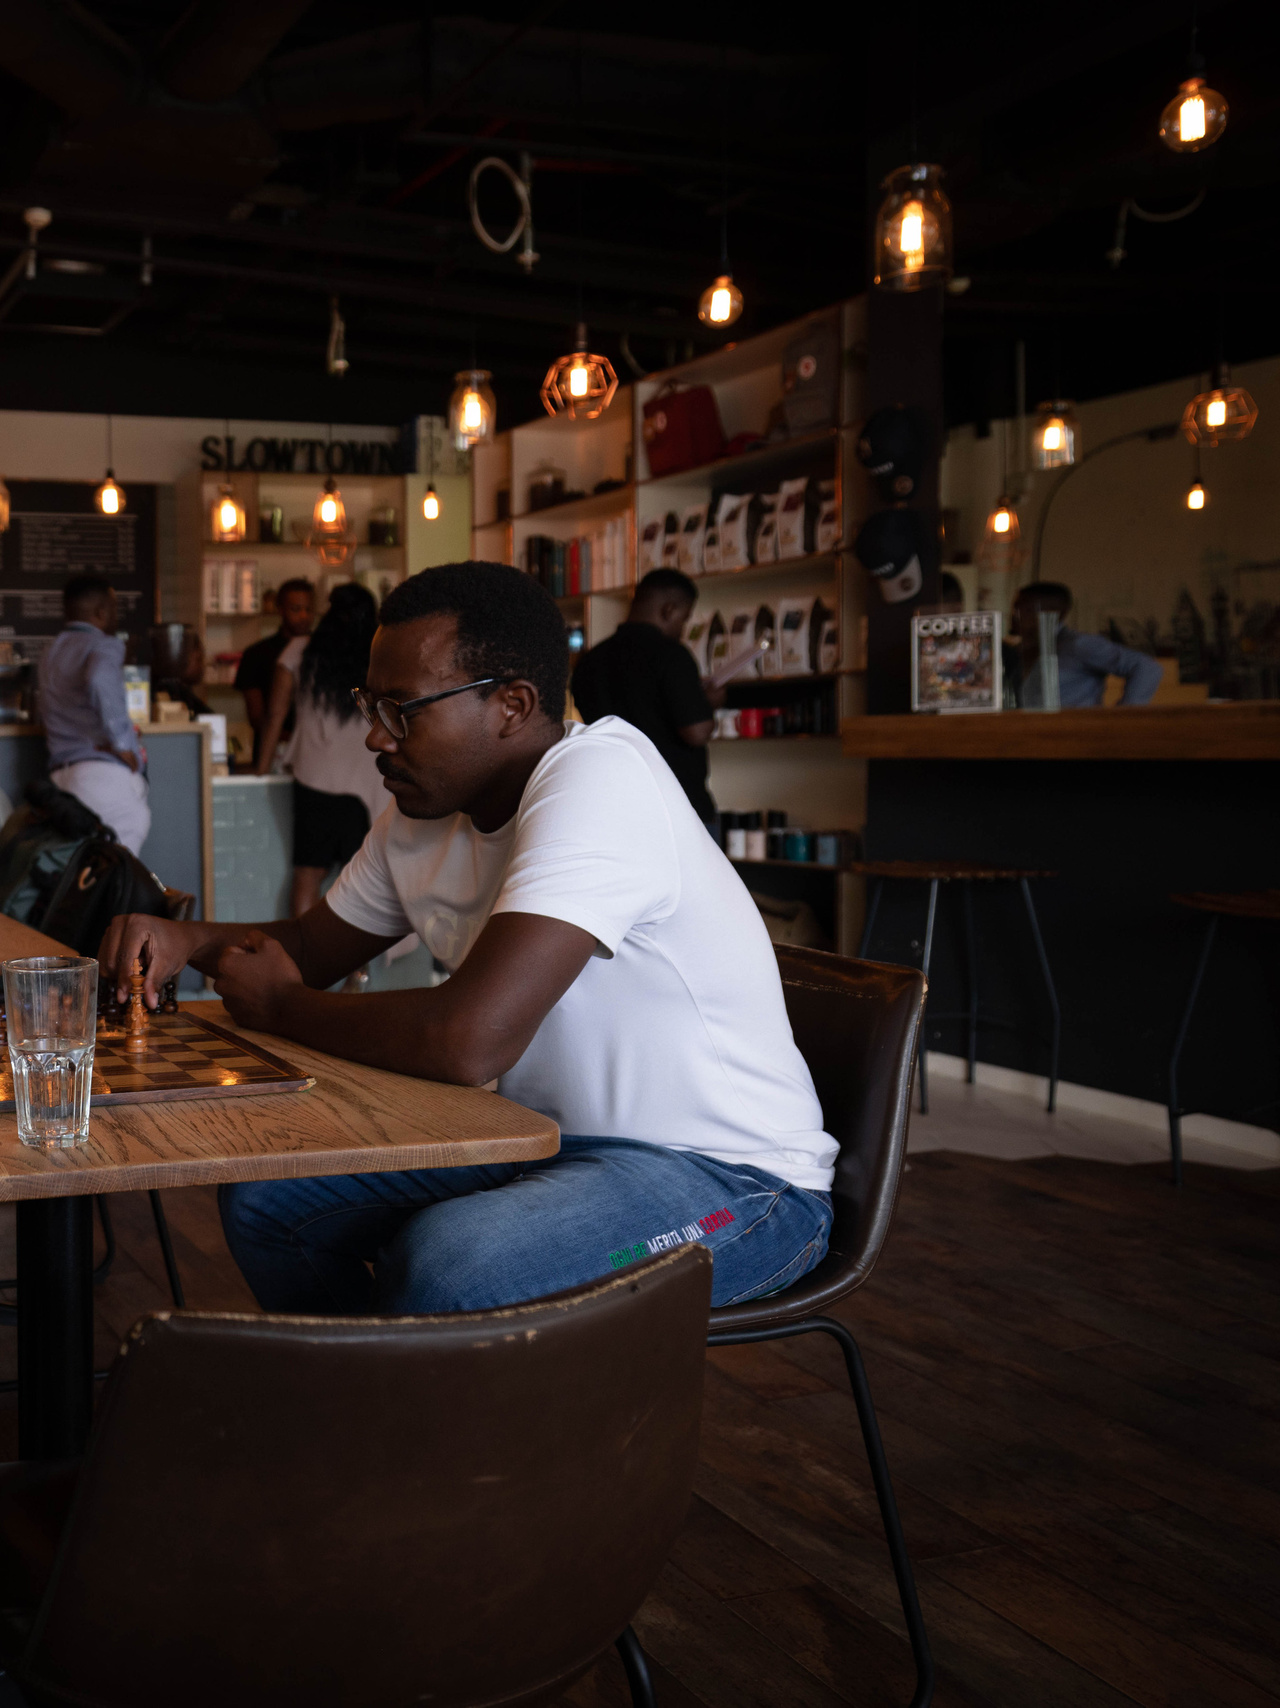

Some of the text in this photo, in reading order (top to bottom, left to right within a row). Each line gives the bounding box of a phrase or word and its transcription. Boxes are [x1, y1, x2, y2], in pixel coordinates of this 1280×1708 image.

[201, 435, 403, 474] SLOWTOWN
[919, 615, 995, 637] COFFEE
[609, 1247, 634, 1270] OGNI
[647, 1230, 684, 1254] MERITA
[681, 1222, 705, 1242] UNA
